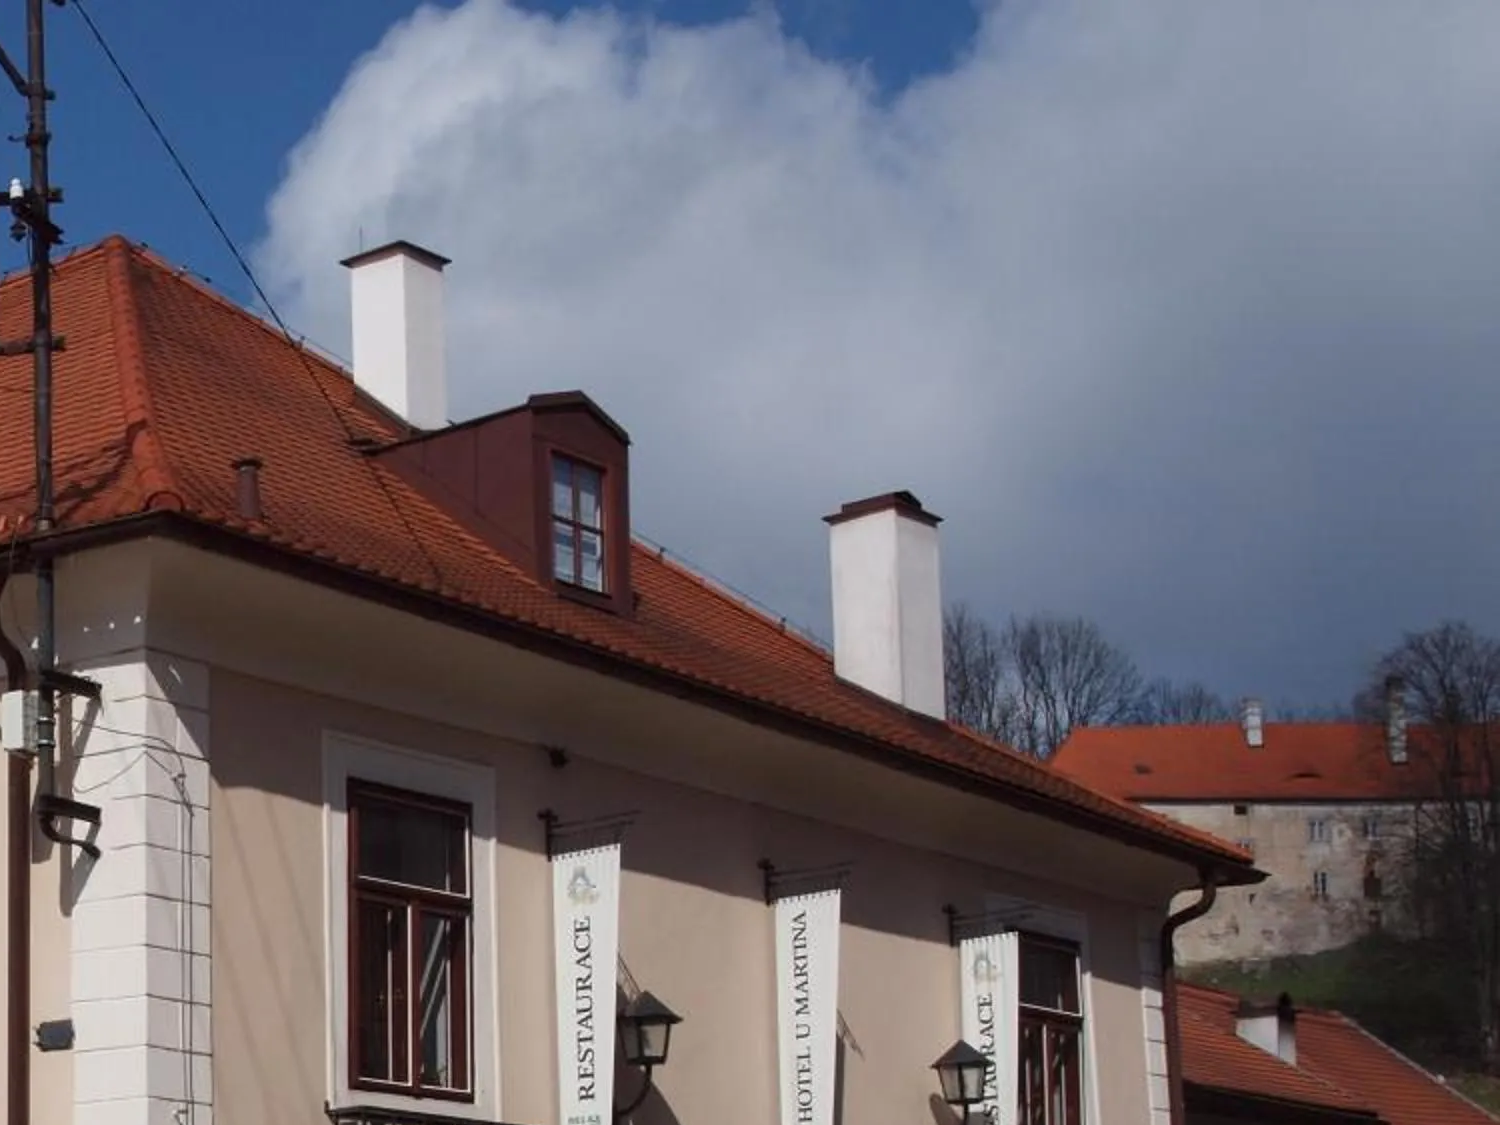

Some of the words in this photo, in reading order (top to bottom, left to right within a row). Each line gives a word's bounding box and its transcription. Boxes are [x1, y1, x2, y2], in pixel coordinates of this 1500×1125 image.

[573, 915, 595, 1102] RESTAURACE
[793, 910, 811, 1018] MARTINA
[794, 1023, 811, 1040] U
[793, 1046, 813, 1124] HOTEL
